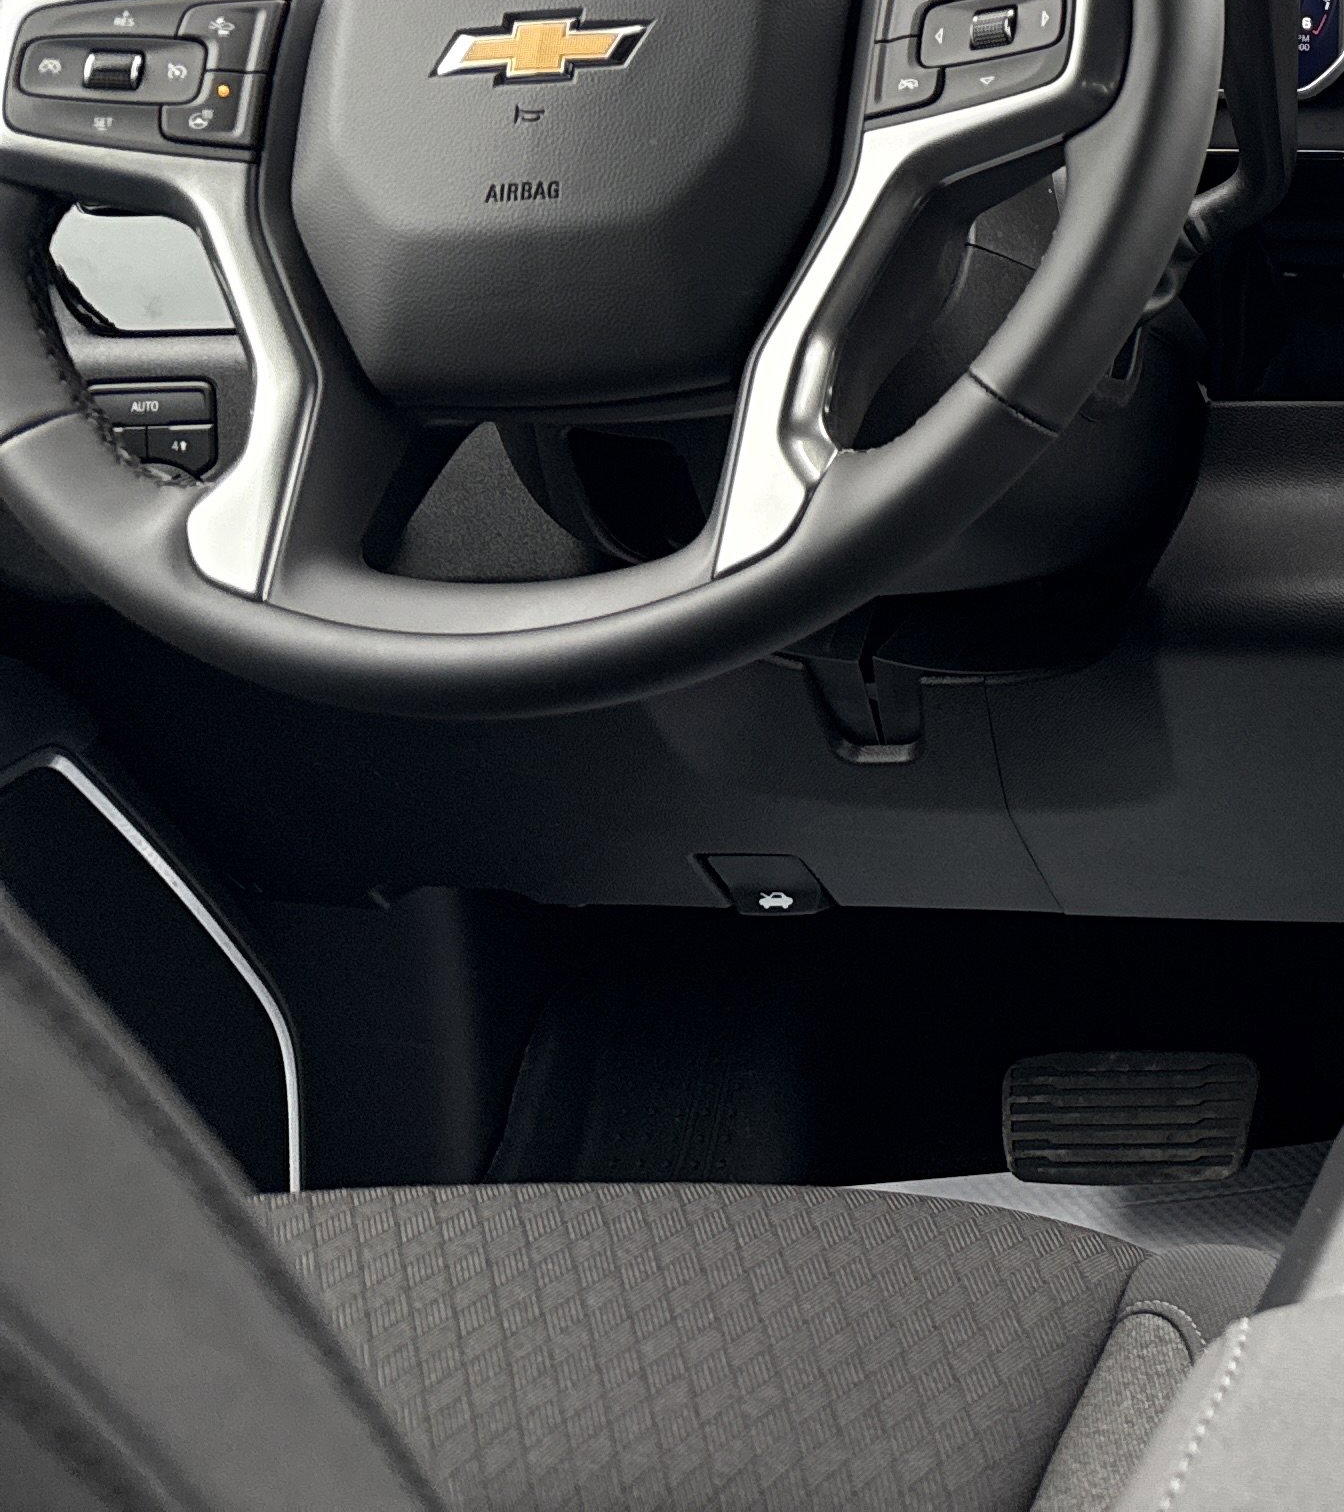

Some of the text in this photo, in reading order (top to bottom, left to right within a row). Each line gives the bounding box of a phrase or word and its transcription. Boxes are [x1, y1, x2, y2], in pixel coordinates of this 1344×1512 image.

[1302, 17, 1312, 29] 6
[484, 180, 560, 203] AIRBAG
[130, 401, 159, 413] AUTO
